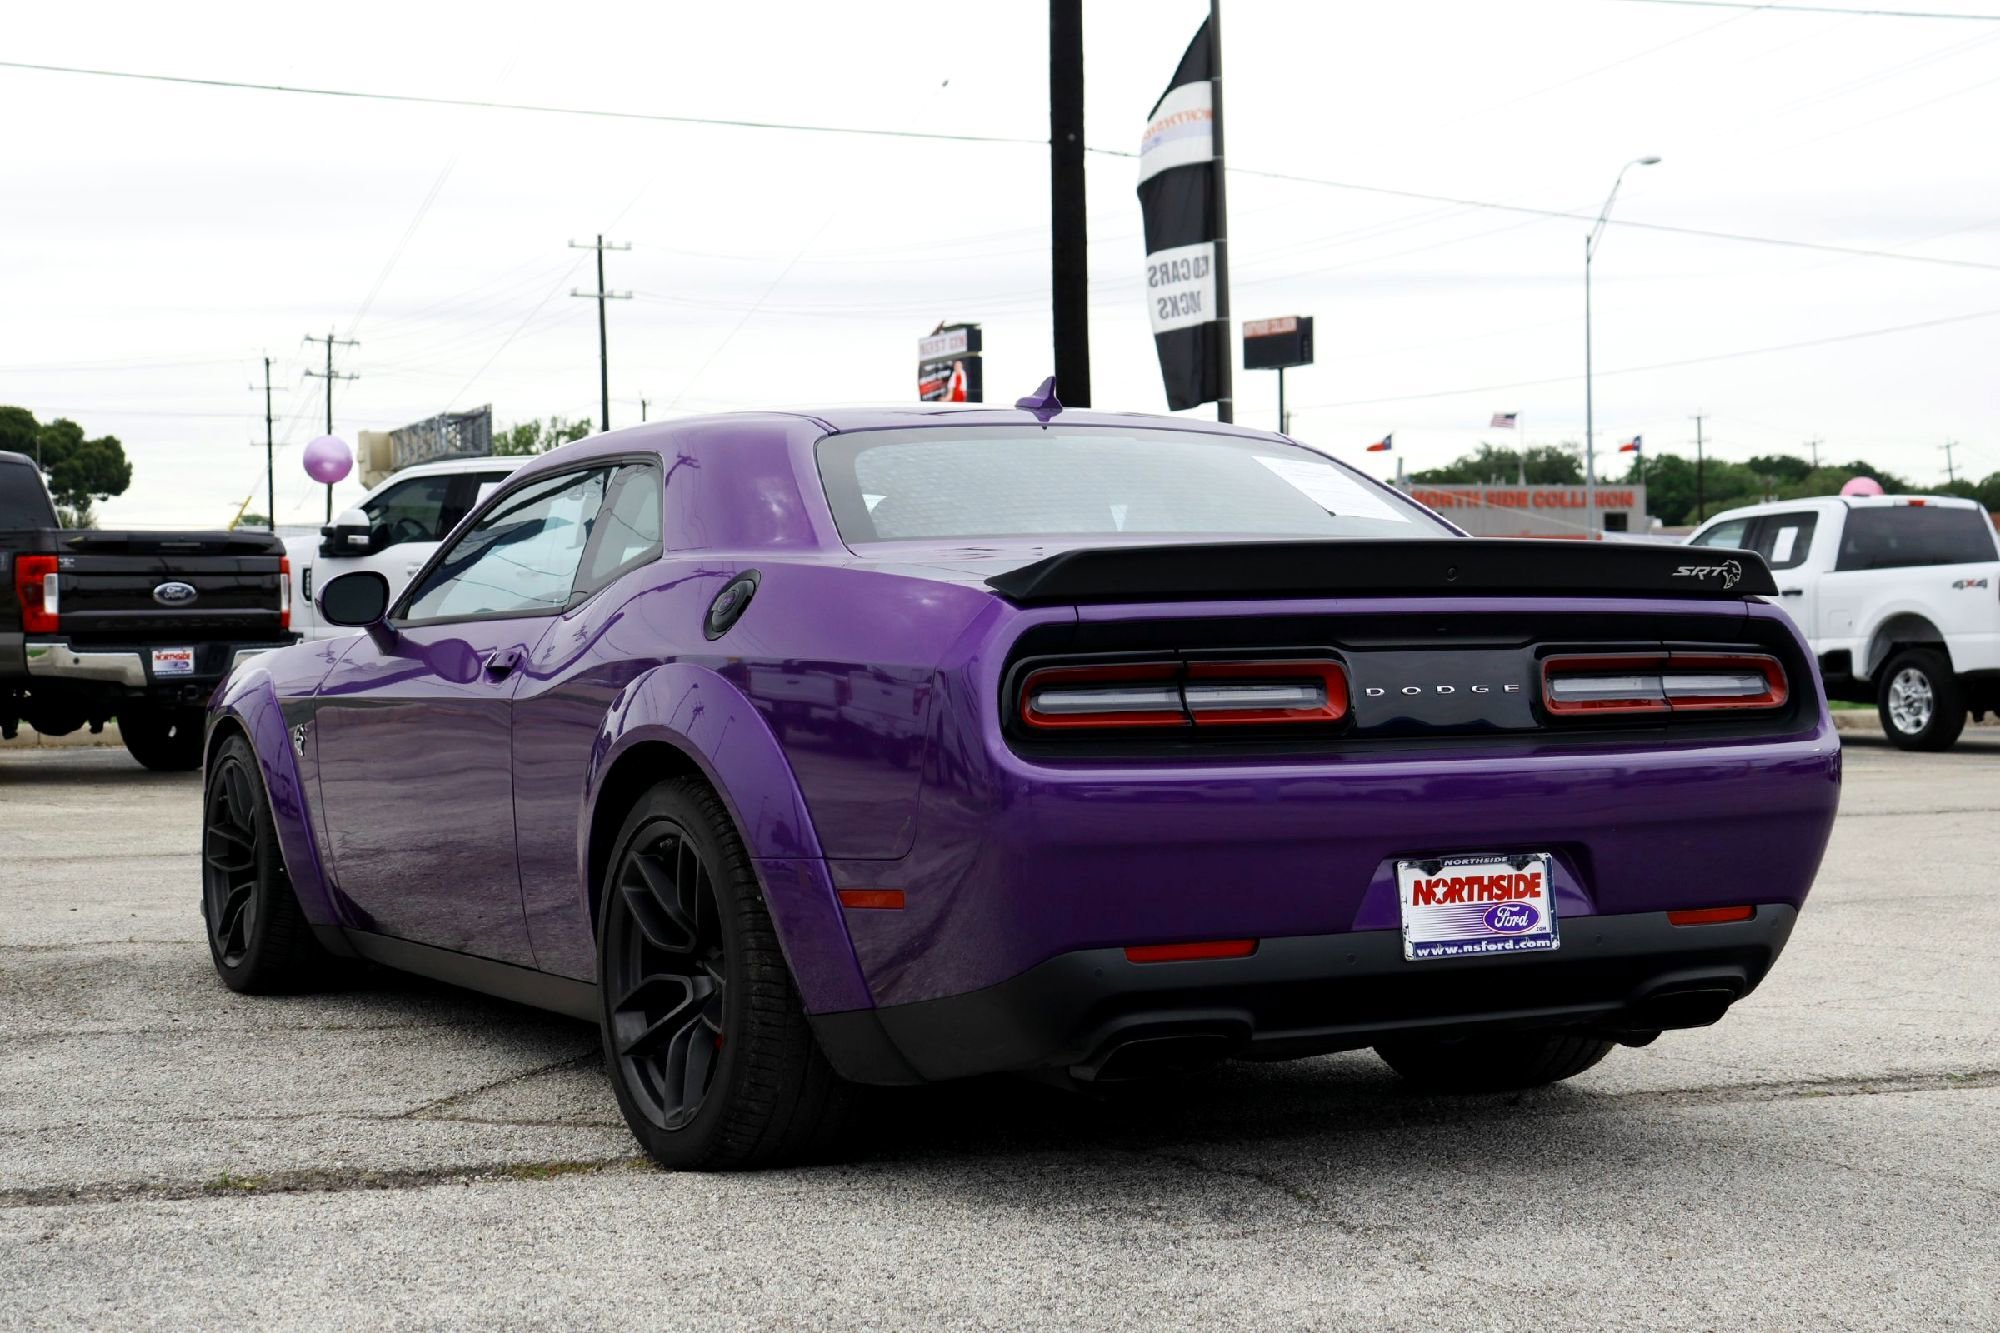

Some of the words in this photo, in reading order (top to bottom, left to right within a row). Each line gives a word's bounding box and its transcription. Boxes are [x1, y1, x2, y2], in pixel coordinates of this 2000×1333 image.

[1411, 490, 1481, 508] NORTH
[1486, 490, 1528, 508] SIDE
[1532, 490, 1634, 508] COLLIION
[1672, 566, 1728, 580] SRT
[1366, 684, 1520, 697] DODGE
[1444, 856, 1508, 866] NORTHSIDE
[1413, 872, 1542, 907] NORTHSIDE
[1494, 906, 1529, 928] Ford
[1416, 938, 1551, 957] www.nsford.com
